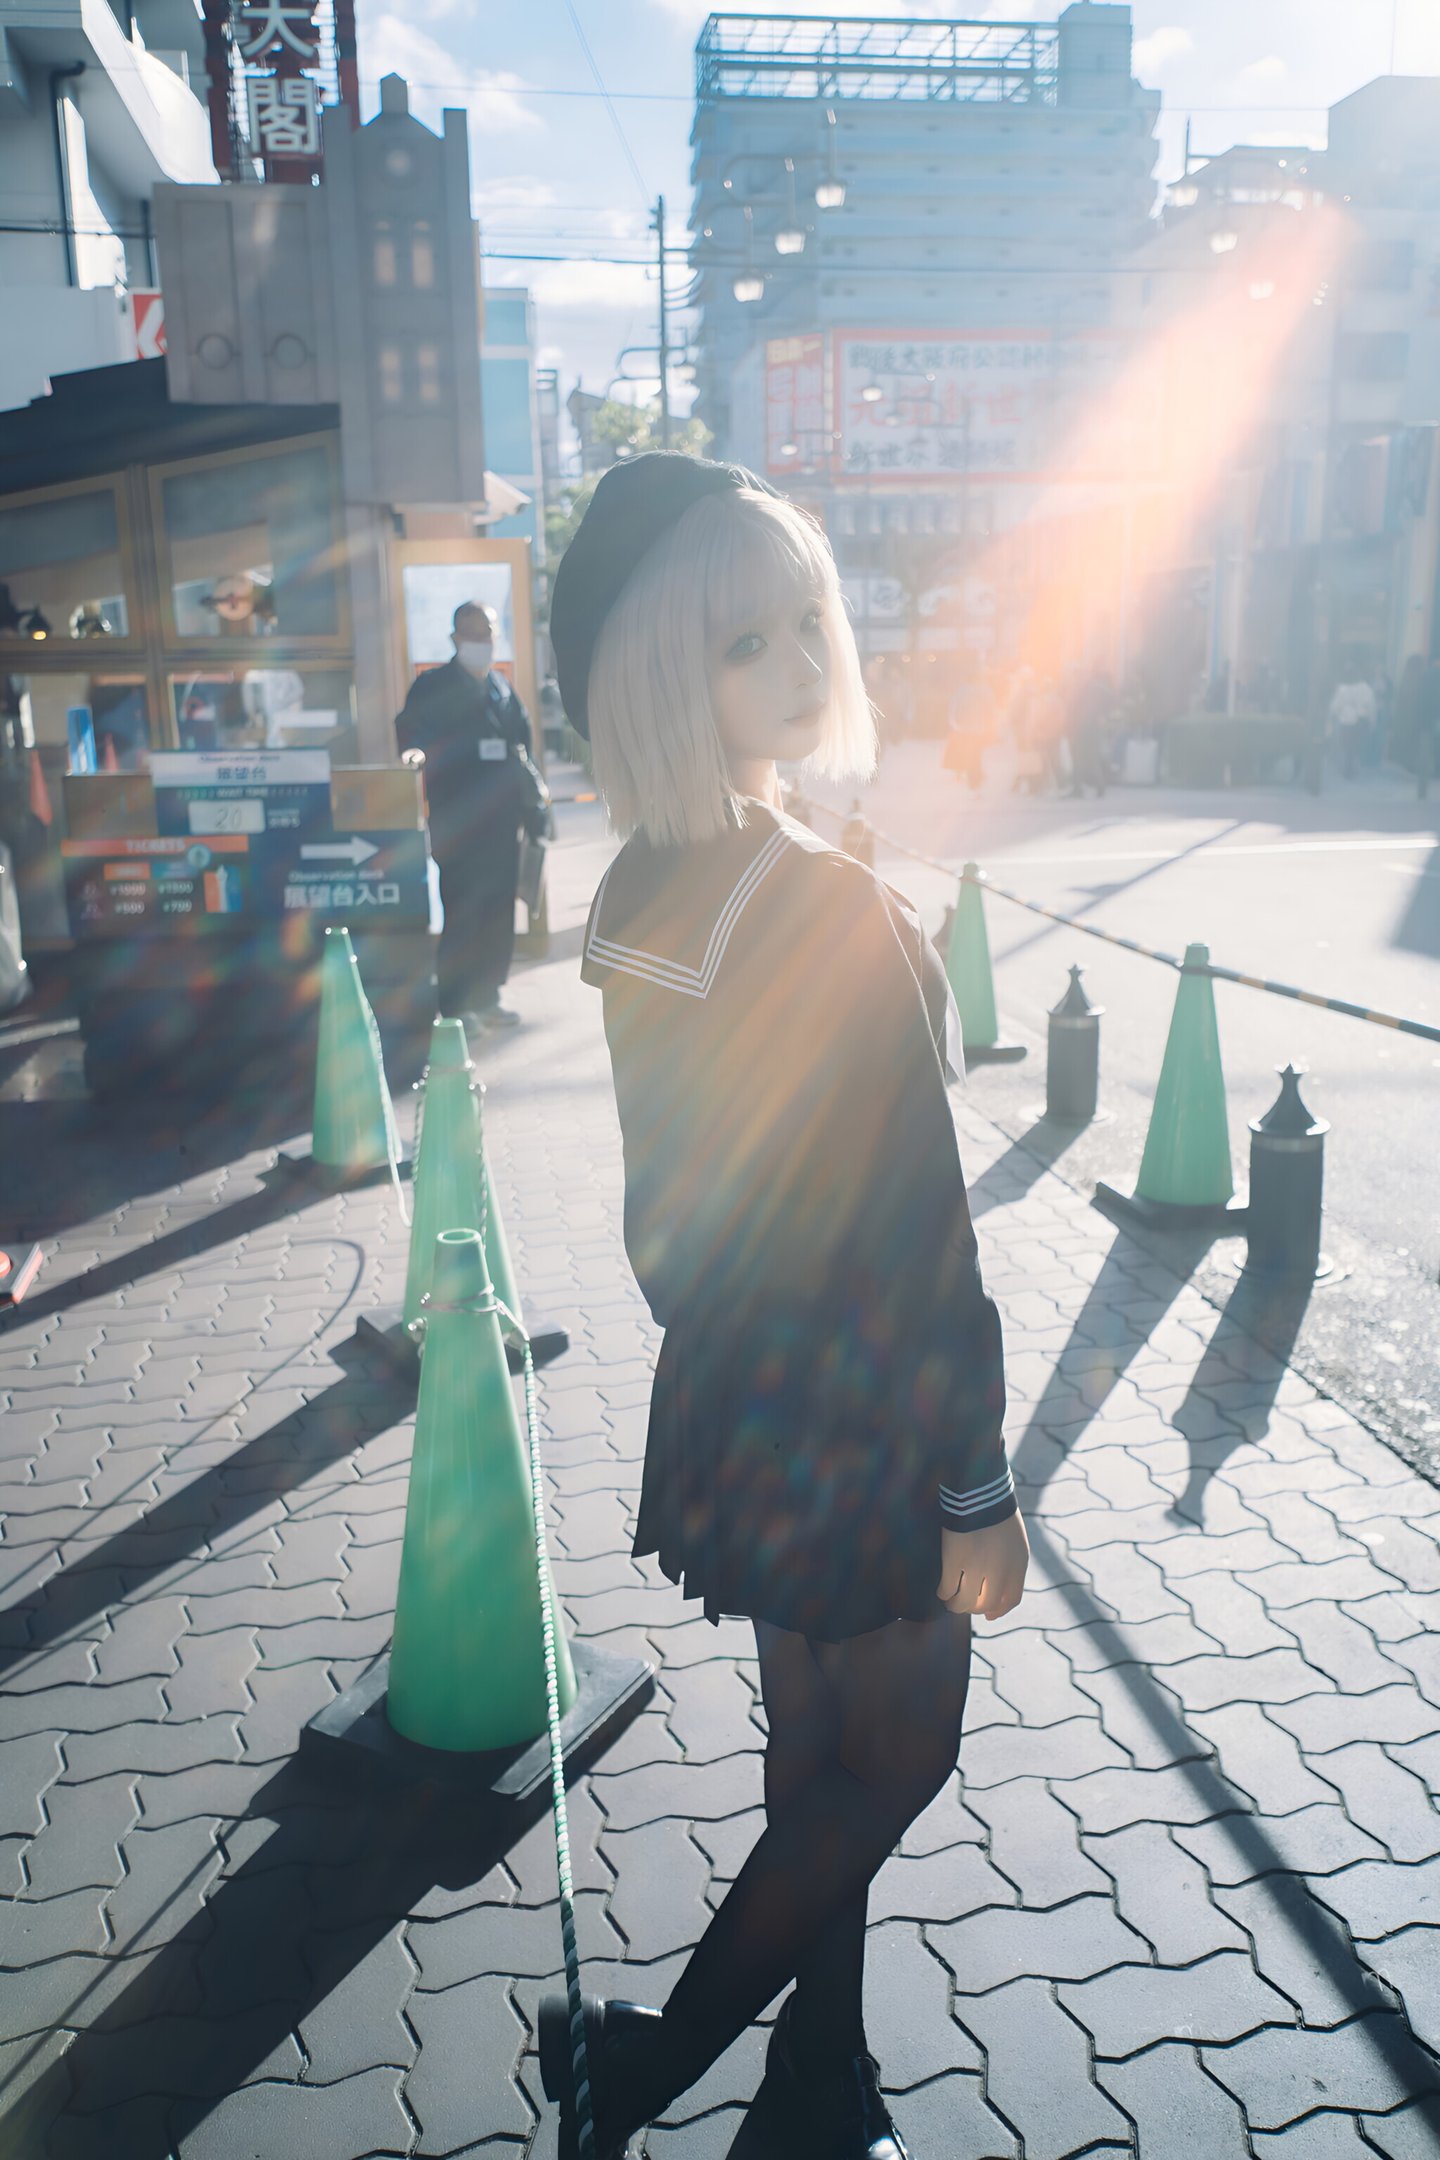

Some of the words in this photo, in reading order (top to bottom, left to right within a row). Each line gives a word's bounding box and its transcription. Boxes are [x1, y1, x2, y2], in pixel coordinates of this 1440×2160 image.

[216, 766, 266, 780] 展望台
[126, 837, 185, 853] TICKETS
[284, 883, 400, 908] 展望台入口
